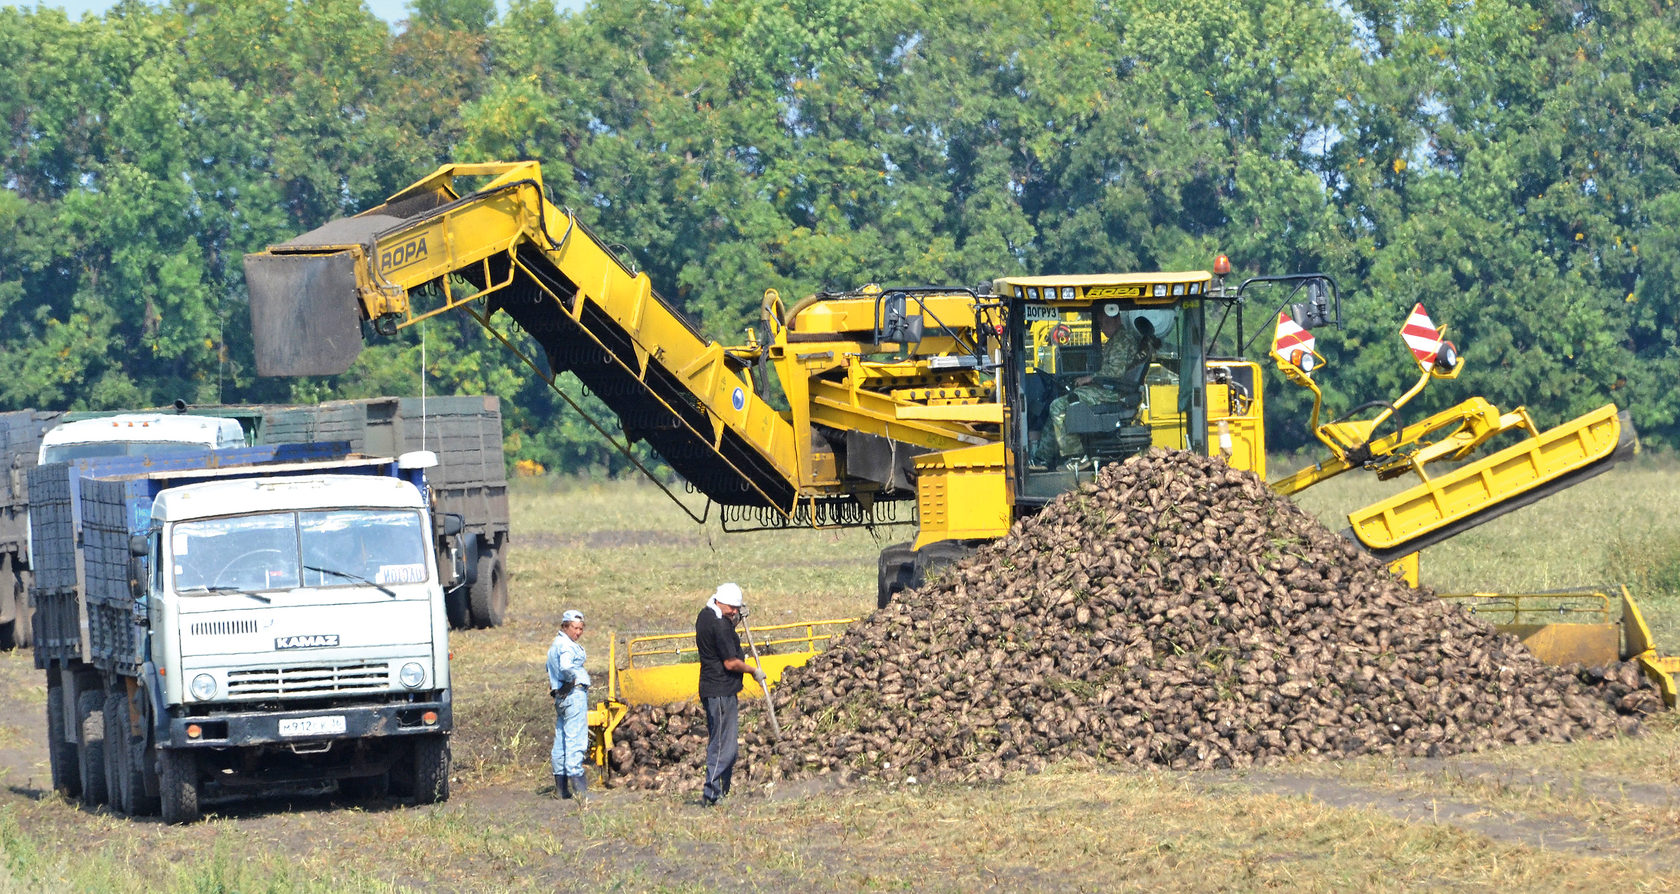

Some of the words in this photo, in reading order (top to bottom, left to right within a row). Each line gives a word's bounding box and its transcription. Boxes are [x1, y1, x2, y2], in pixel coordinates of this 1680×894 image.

[381, 237, 428, 271] ROPA
[1086, 287, 1140, 298] ROPA
[1027, 306, 1057, 318] ДОГРУЗ
[276, 635, 338, 648] KAMAZ
